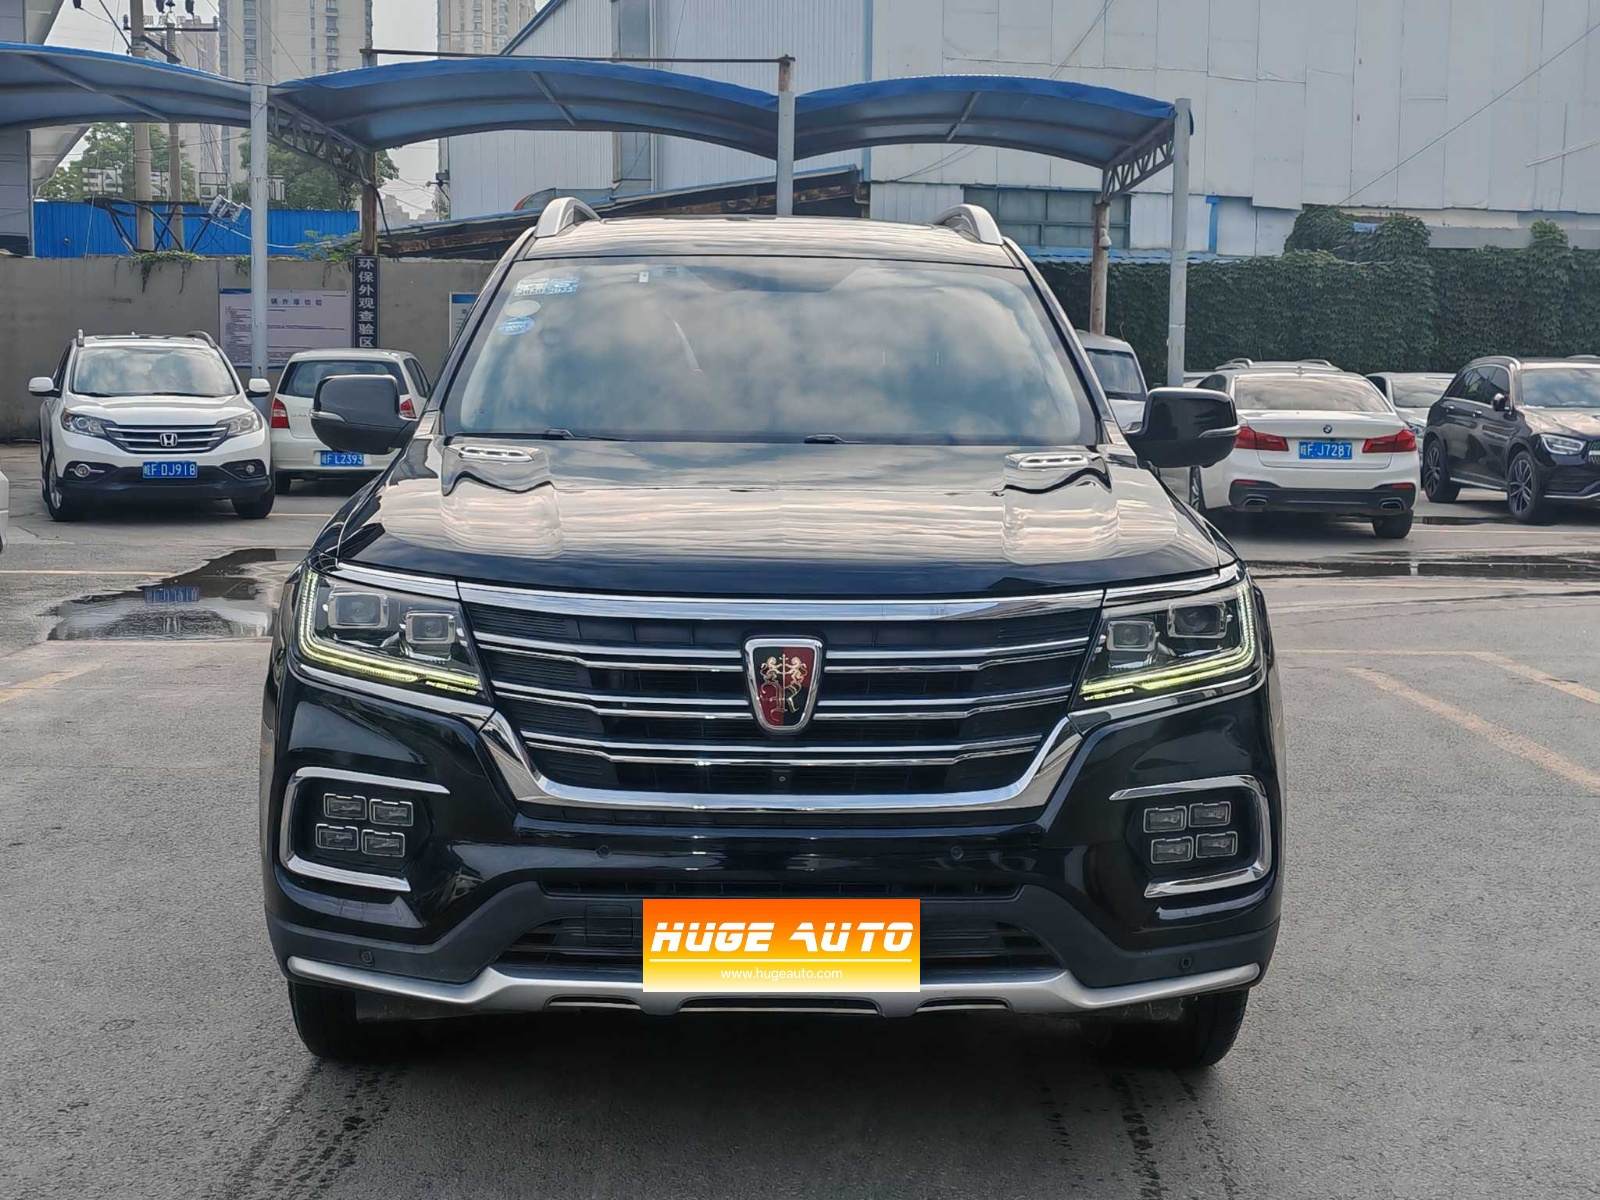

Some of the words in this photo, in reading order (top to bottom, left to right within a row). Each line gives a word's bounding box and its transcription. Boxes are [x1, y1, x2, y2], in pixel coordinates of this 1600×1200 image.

[358, 258, 375, 348] 环保外观查验区
